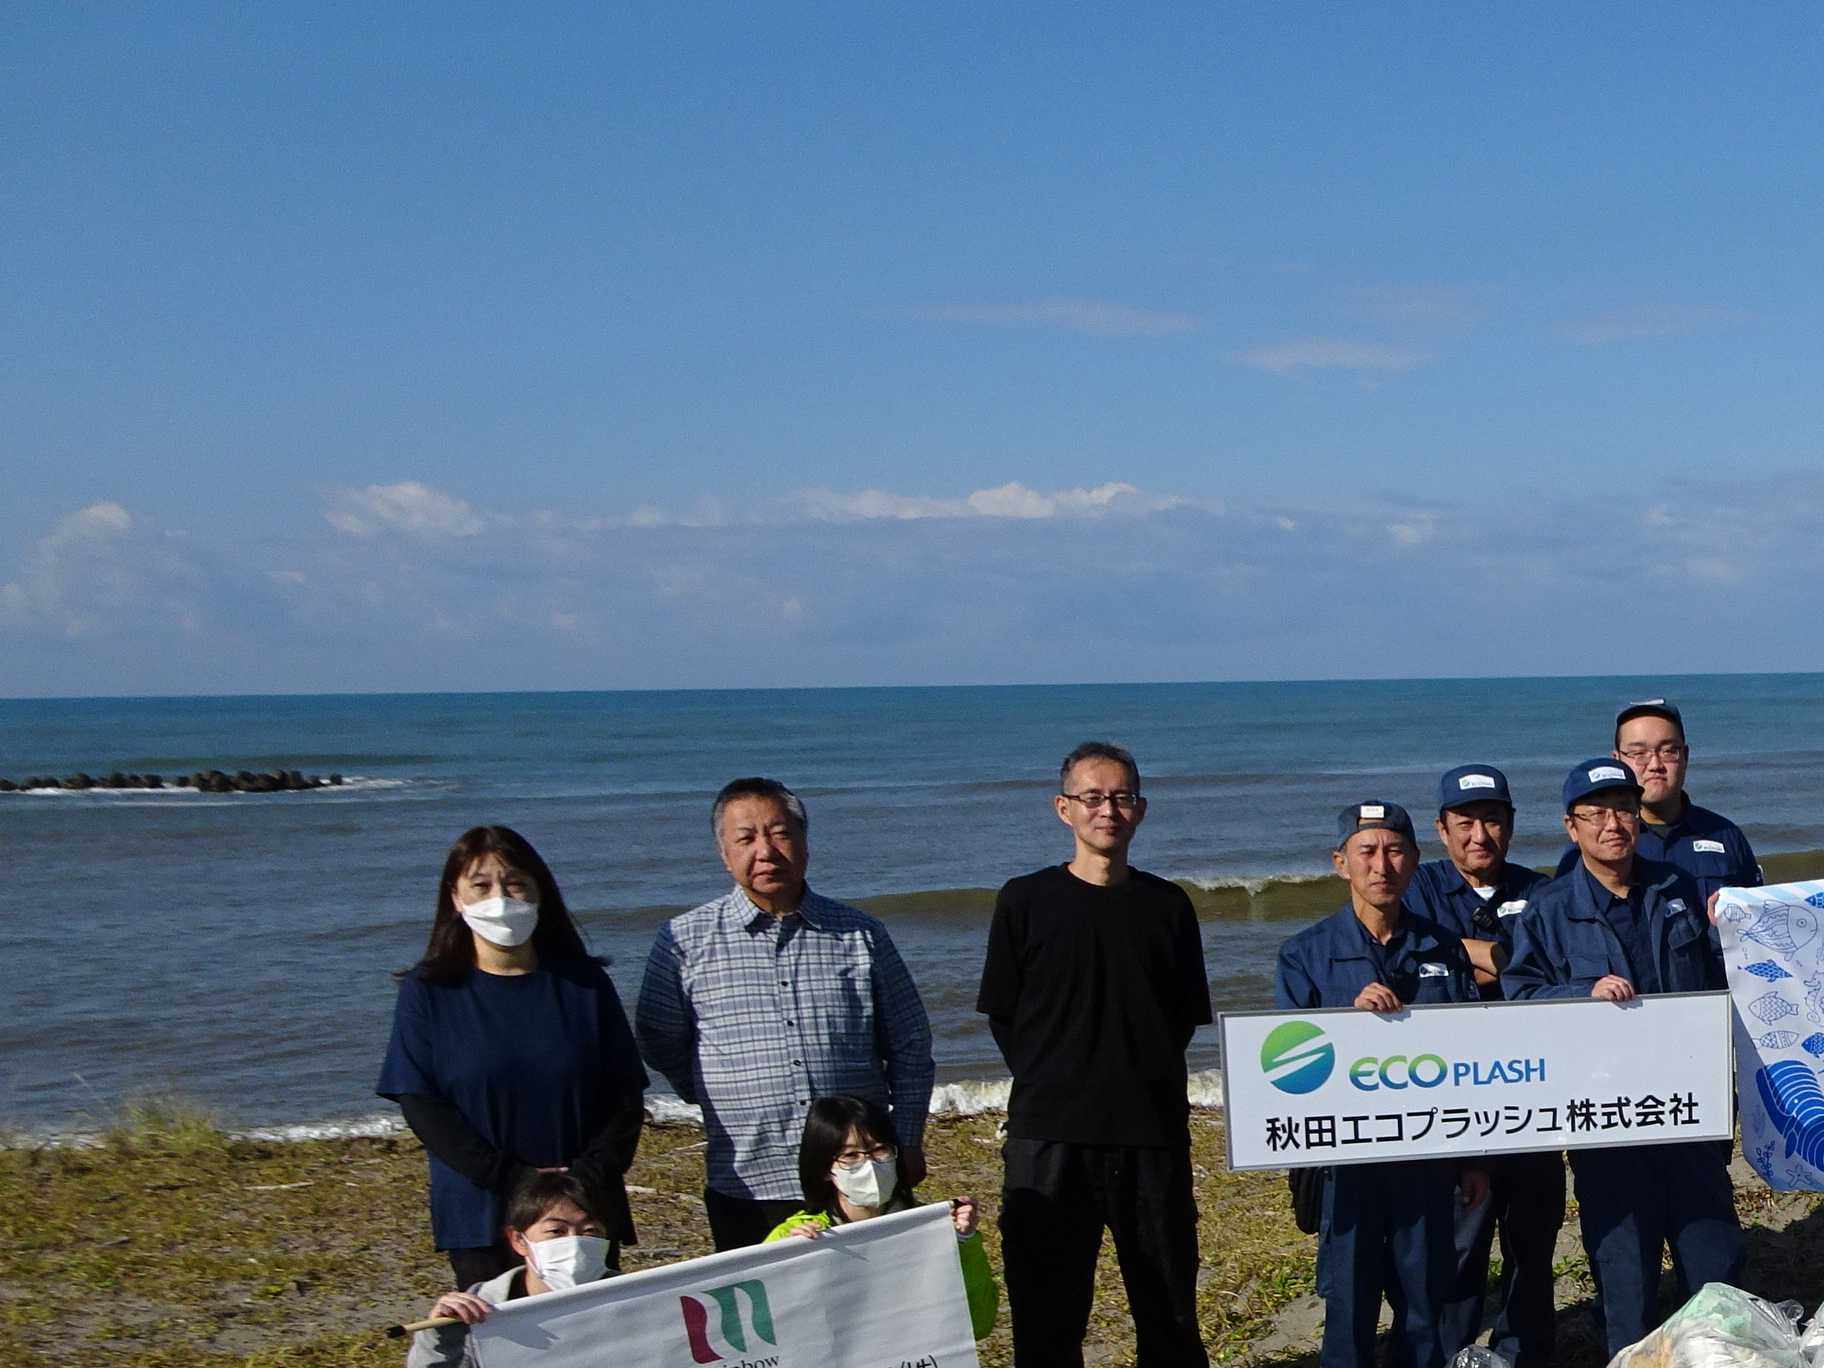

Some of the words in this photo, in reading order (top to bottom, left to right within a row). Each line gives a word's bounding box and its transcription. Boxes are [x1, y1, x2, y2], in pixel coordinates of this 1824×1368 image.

[1453, 1058, 1547, 1088] PLASH
[1264, 1092, 1700, 1152] 秋田エコプラッシュ株式会社
